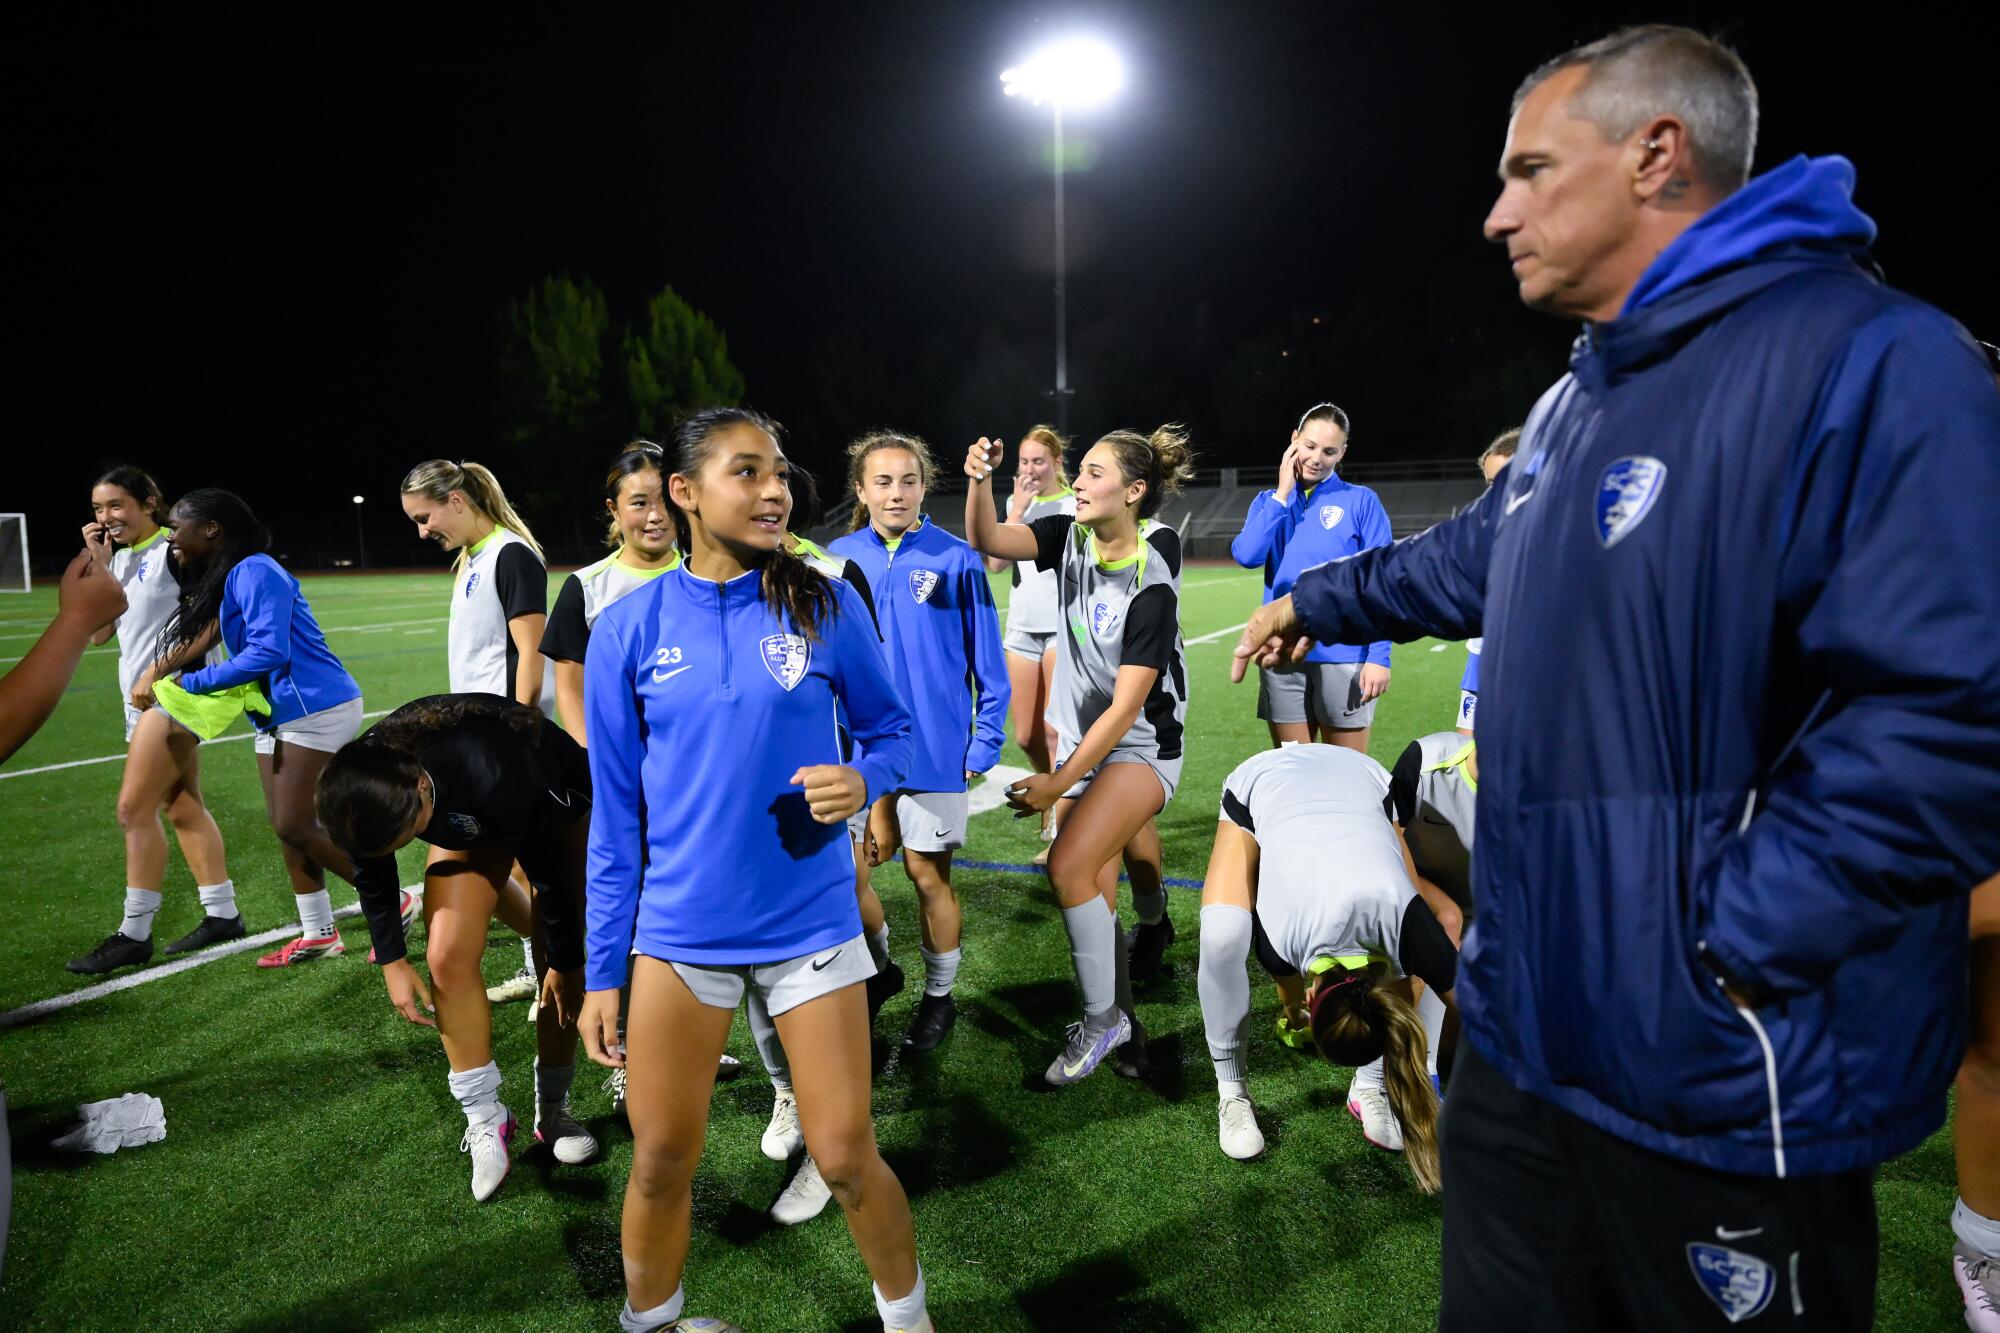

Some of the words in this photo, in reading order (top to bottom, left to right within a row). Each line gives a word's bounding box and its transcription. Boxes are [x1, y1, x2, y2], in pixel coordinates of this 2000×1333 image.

[657, 646, 682, 664] 23
[767, 643, 804, 655] SCFC
[1698, 1253, 1760, 1281] SCFC
